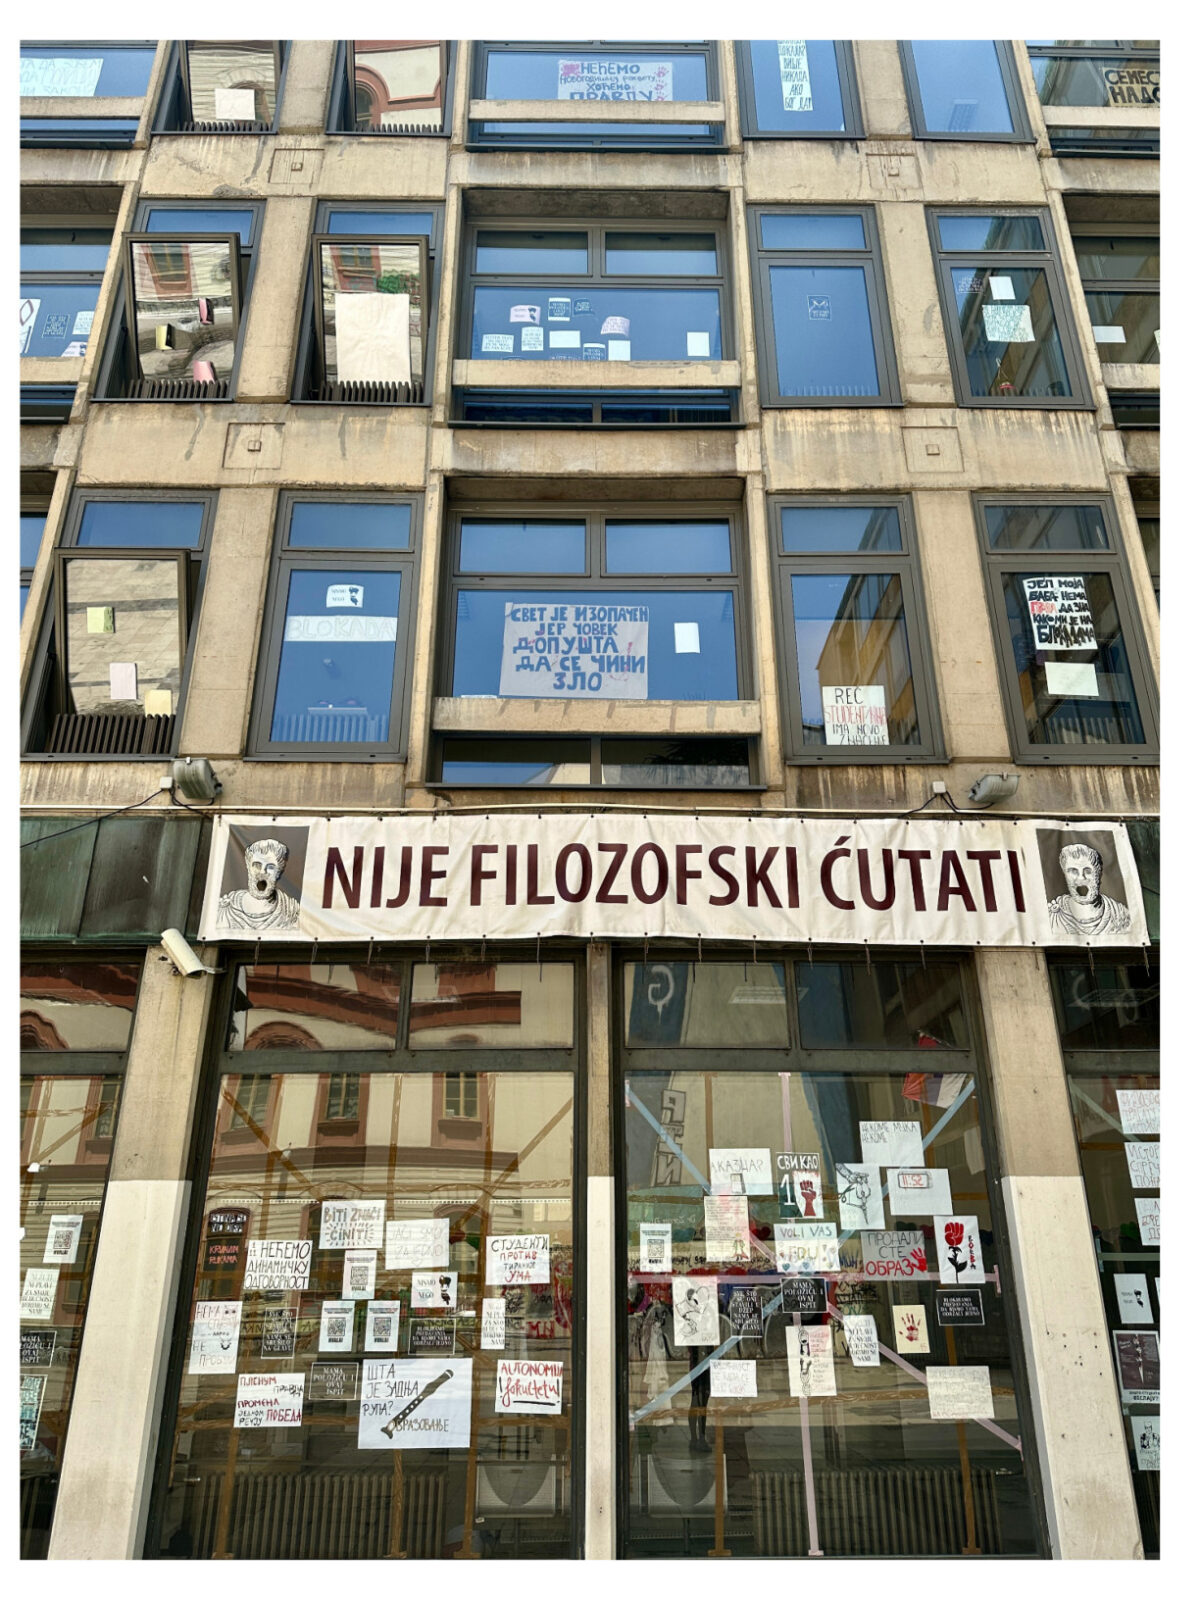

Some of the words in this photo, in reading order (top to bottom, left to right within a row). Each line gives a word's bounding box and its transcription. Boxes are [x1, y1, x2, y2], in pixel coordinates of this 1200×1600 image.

[581, 63, 640, 75] НЕЋЕМО
[1104, 70, 1160, 85] СЕМЕС
[1061, 591, 1087, 600] НЕМА
[511, 607, 547, 622] СВЕТ
[550, 606, 568, 622] ЈЕ
[575, 606, 648, 622] ИЗОПАЧЕН
[1058, 603, 1073, 613] ДА
[1073, 602, 1090, 613] ЗНА
[1069, 614, 1079, 625] ЈЕ
[1080, 614, 1093, 624] НА
[286, 618, 396, 639] BLOKADA
[535, 623, 565, 636] ЈЕР
[574, 623, 618, 636] ЧОВЕК
[513, 637, 619, 654] ДОПУШТА
[515, 655, 552, 672] ДА
[560, 655, 581, 672] СЕ
[591, 655, 645, 673] ЧИНИ
[553, 672, 603, 691] ЗЛО
[835, 687, 864, 705] REČ
[833, 724, 849, 735] IMA
[322, 844, 448, 910] NIJE
[469, 842, 798, 908] FILOZOFSKI
[819, 834, 1026, 912] ĆUTATI
[777, 1155, 798, 1170] СВИ
[800, 1155, 819, 1170] КАО
[780, 1226, 804, 1238] VOLI
[810, 1225, 832, 1237] VAS
[260, 1242, 310, 1259] НЕЋЕМО
[491, 1238, 548, 1252] СТУДЕНТИ
[879, 1246, 906, 1258] СТЕ
[500, 1251, 537, 1260] ПРОТИВ
[247, 1260, 309, 1275] ДИНАМИЧКУ
[865, 1259, 914, 1276] ОБРАЗ
[244, 1274, 308, 1289] ОДГОВОРНОСТ
[505, 1270, 532, 1283] УМА
[368, 1363, 396, 1380] ШТА
[501, 1362, 562, 1377] AUTONOMIJA
[240, 1376, 277, 1386] ПЛЕНУМ
[366, 1382, 383, 1398] ЈЕ
[386, 1381, 420, 1398] ЗАДЊА
[237, 1398, 280, 1408] ПРОМЕНА
[362, 1401, 394, 1416] РУПА?
[266, 1409, 301, 1422] ПОБЕДА
